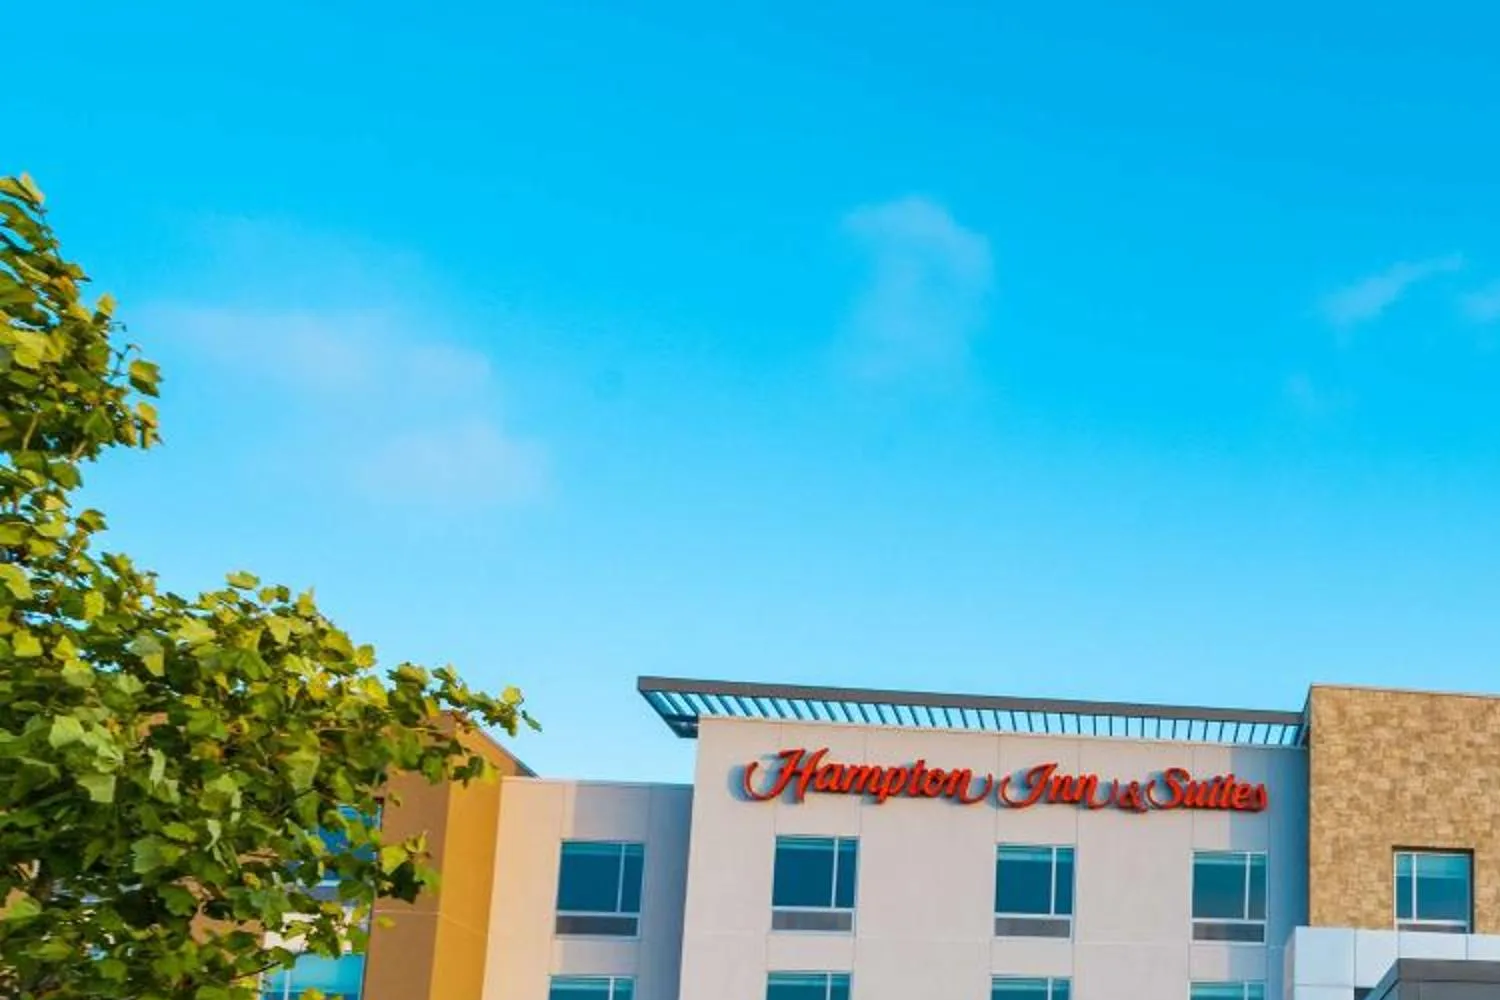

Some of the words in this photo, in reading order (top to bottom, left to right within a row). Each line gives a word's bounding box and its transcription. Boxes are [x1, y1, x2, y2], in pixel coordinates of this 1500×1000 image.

[744, 748, 991, 805] Hampton
[1000, 763, 1117, 809] Inn
[1119, 780, 1148, 812] &
[1147, 768, 1268, 812] Suites
